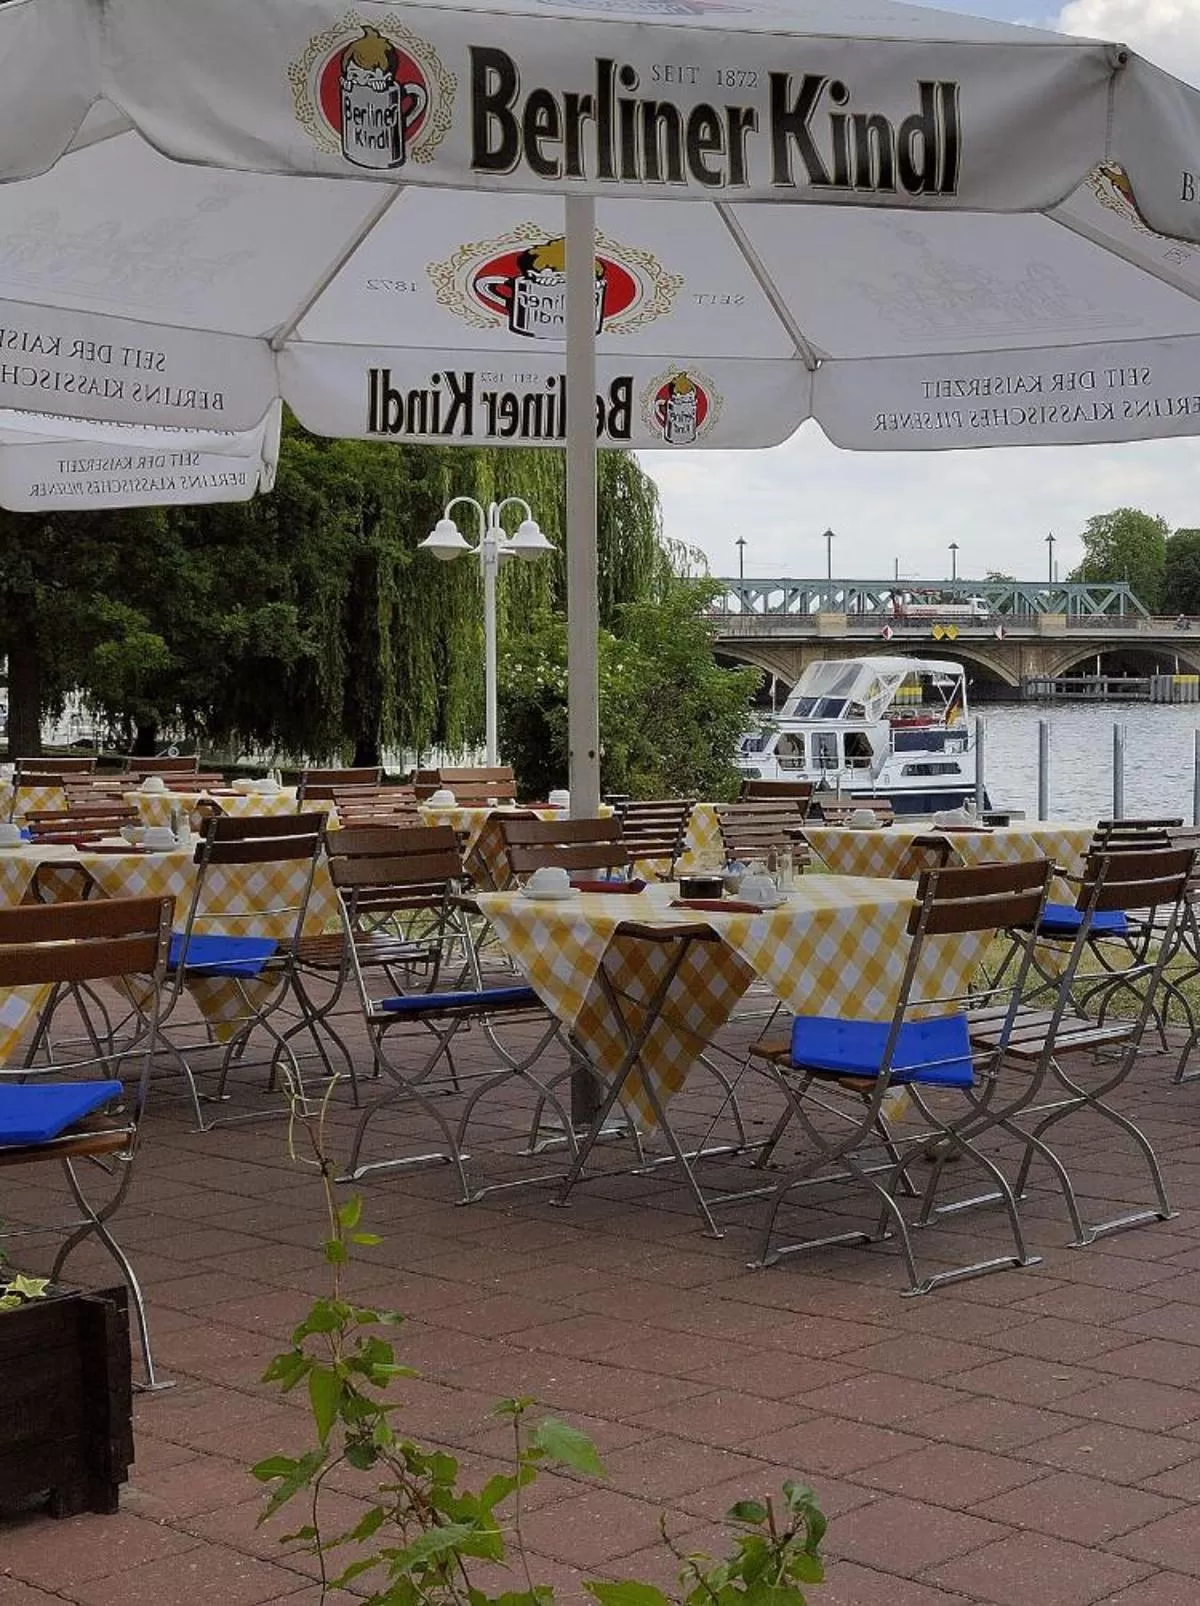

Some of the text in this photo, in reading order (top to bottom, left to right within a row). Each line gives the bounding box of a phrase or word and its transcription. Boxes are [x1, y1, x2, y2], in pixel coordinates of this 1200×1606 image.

[651, 64, 758, 88] SEIT 1872
[345, 96, 398, 128] Berliner
[469, 45, 960, 196] Berliner Kindl
[355, 127, 390, 149] Kindl
